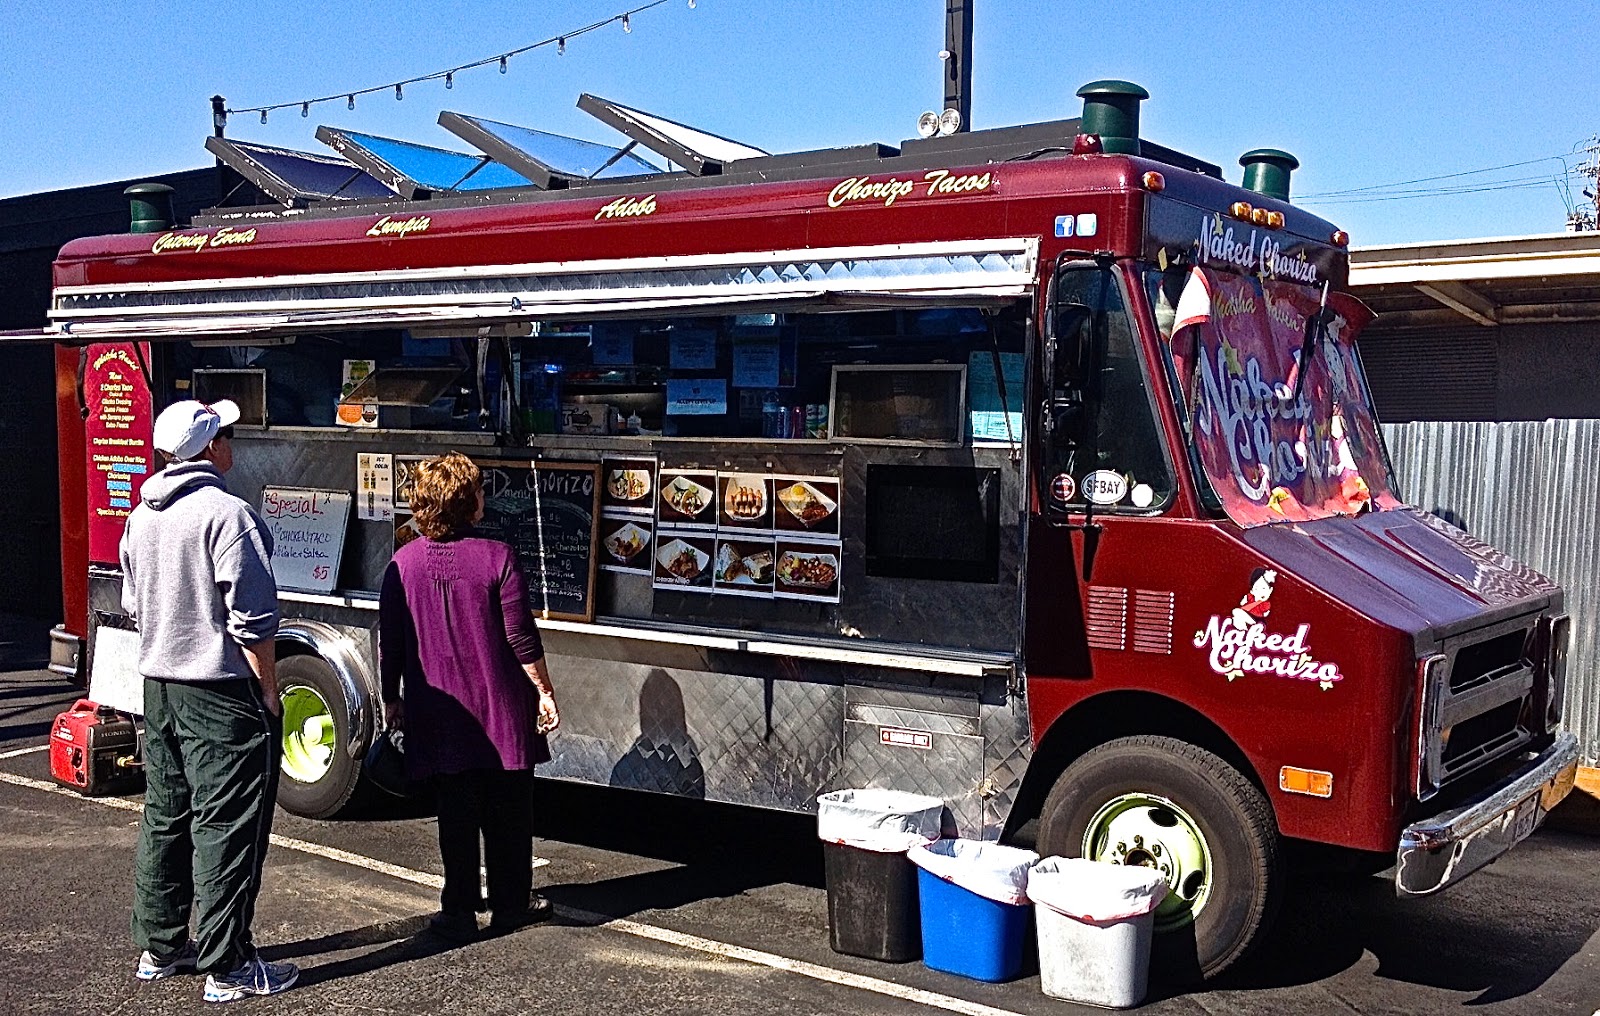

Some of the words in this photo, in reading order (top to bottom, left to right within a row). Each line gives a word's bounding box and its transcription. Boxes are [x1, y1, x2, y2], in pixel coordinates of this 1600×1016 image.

[826, 176, 914, 208] Chorizo
[924, 168, 992, 197] Tacos
[594, 194, 657, 221] Adobo
[151, 231, 207, 255] Catering
[210, 226, 257, 248] Events
[366, 214, 431, 239] Lumpia
[1197, 215, 1257, 267] Naked
[1259, 235, 1318, 284] Chorizo
[1192, 614, 1312, 654] Naked
[1209, 643, 1344, 681] Chorizo
[101, 730, 132, 738] HONDA
